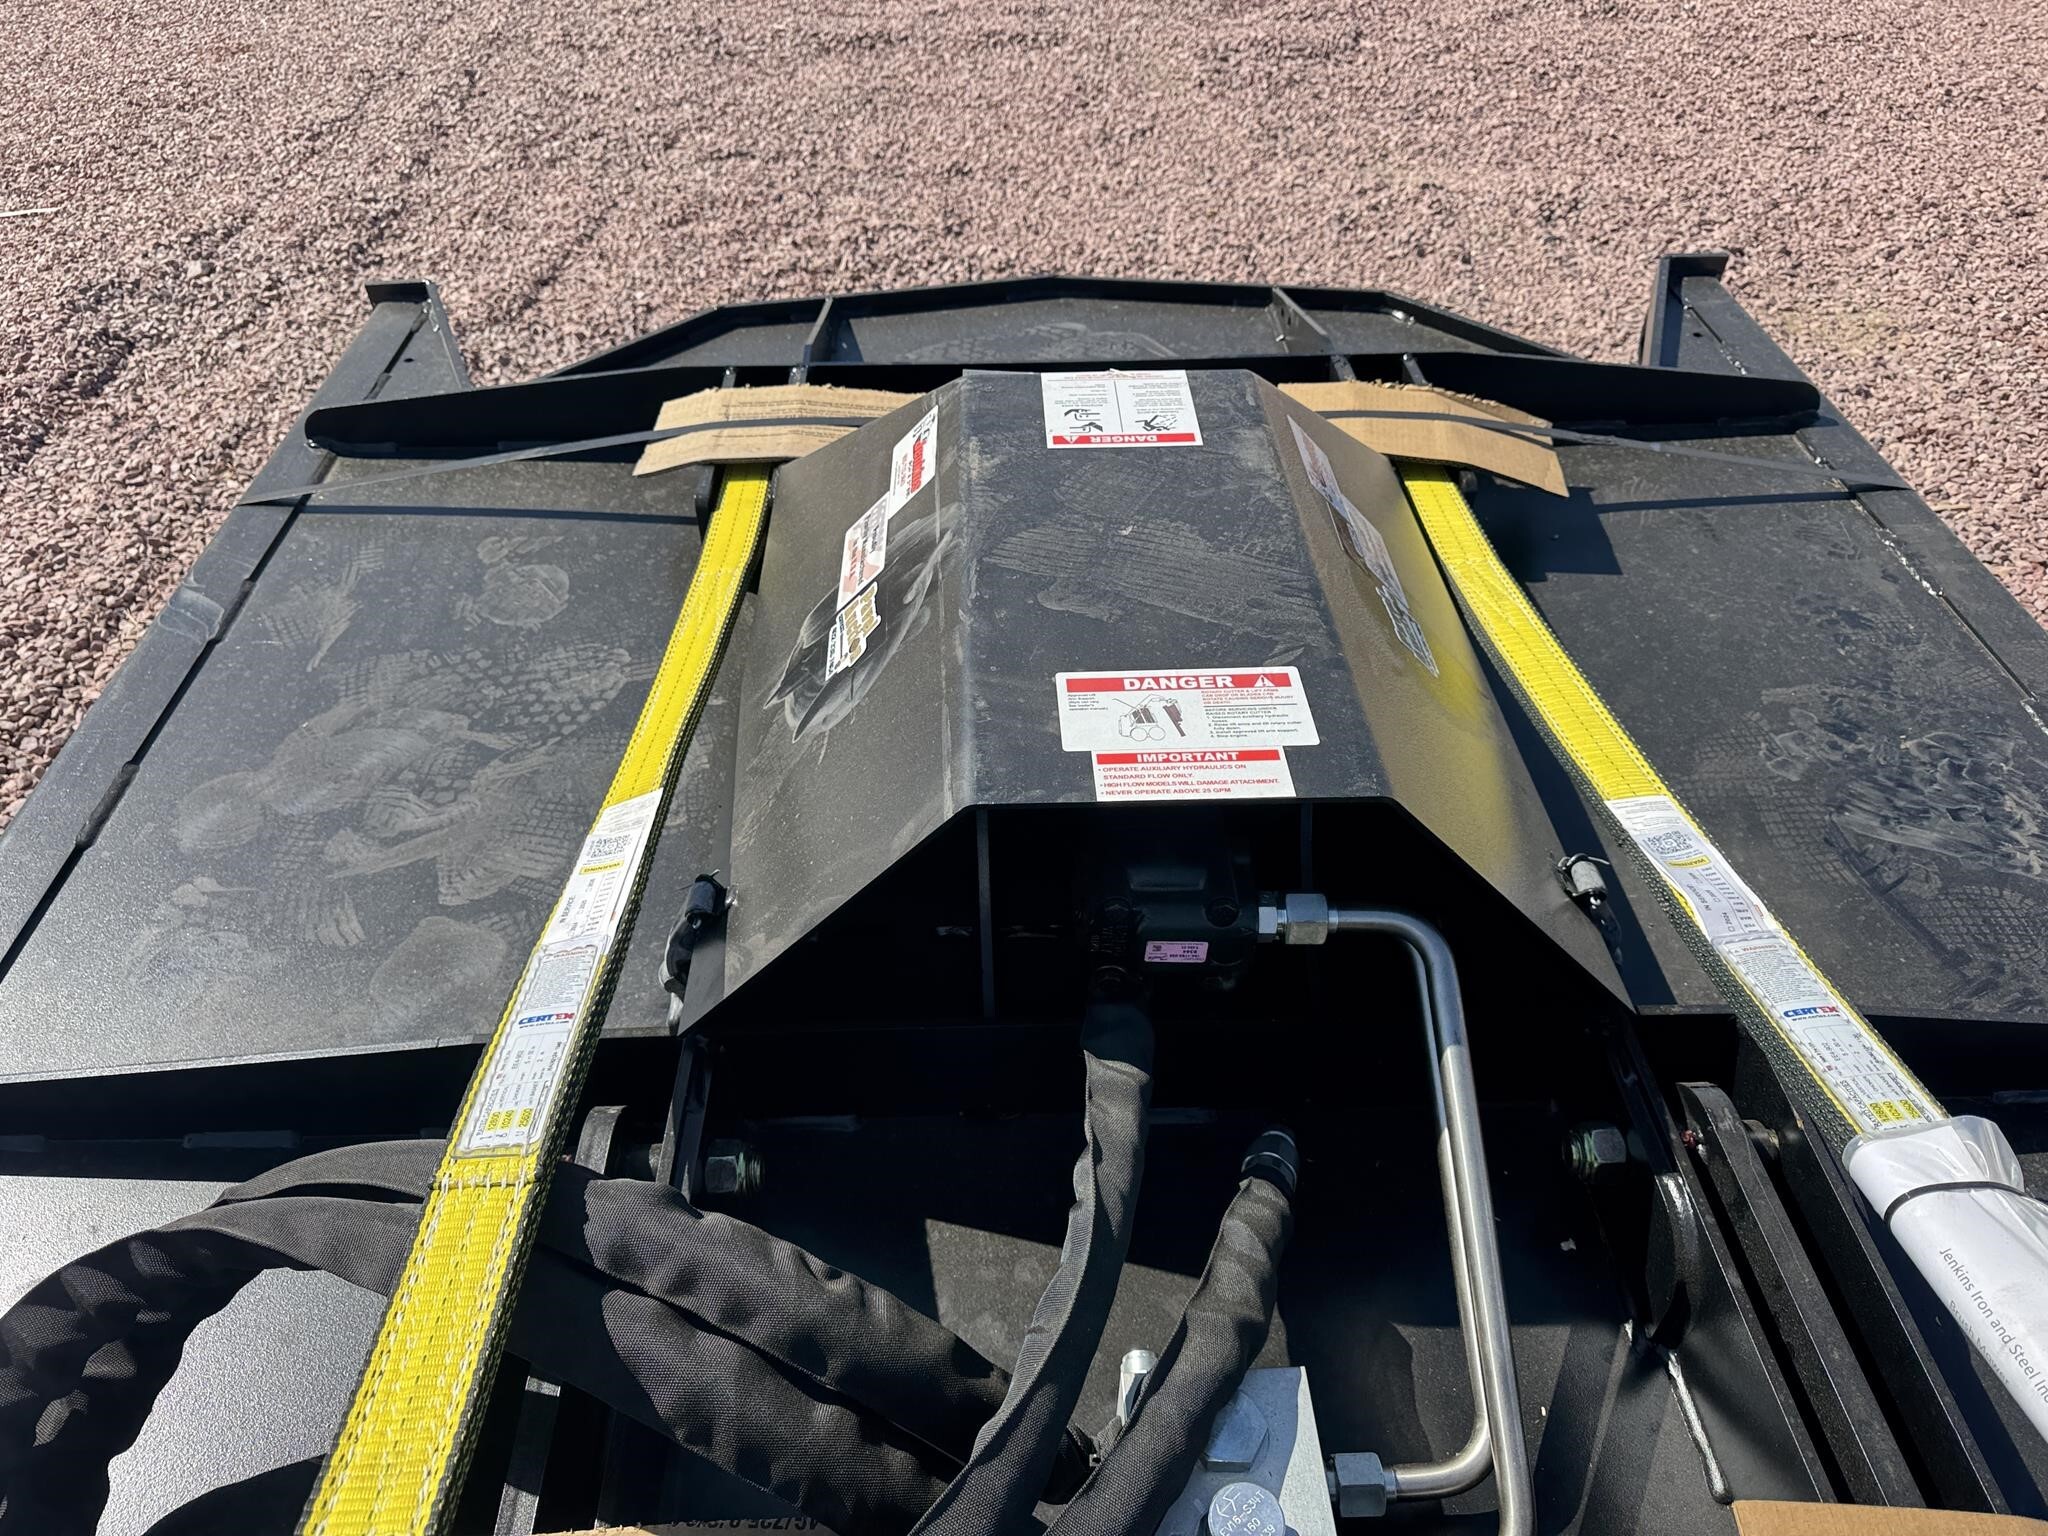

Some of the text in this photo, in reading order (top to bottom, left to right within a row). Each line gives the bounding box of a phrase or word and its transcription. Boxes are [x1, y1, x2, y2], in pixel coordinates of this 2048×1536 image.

[1123, 676, 1235, 690] DANGER
[1137, 752, 1239, 762] IMPORTANT
[518, 1013, 575, 1024] CERTEX
[1784, 1006, 1838, 1017] CERTEX
[1840, 1080, 1867, 1110] CAPACITIES
[501, 1110, 514, 1129] 10240
[1870, 1103, 1890, 1122] 12800
[1883, 1101, 1903, 1120] 10240
[1939, 1248, 1974, 1291] Jenkins
[1971, 1290, 1993, 1318] Iron
[1990, 1320, 2015, 1344] and
[2009, 1344, 2040, 1380] Steel
[1950, 1300, 1974, 1338] Brush
[1244, 1517, 1260, 1535] 160
[1261, 1524, 1275, 1536] 39
